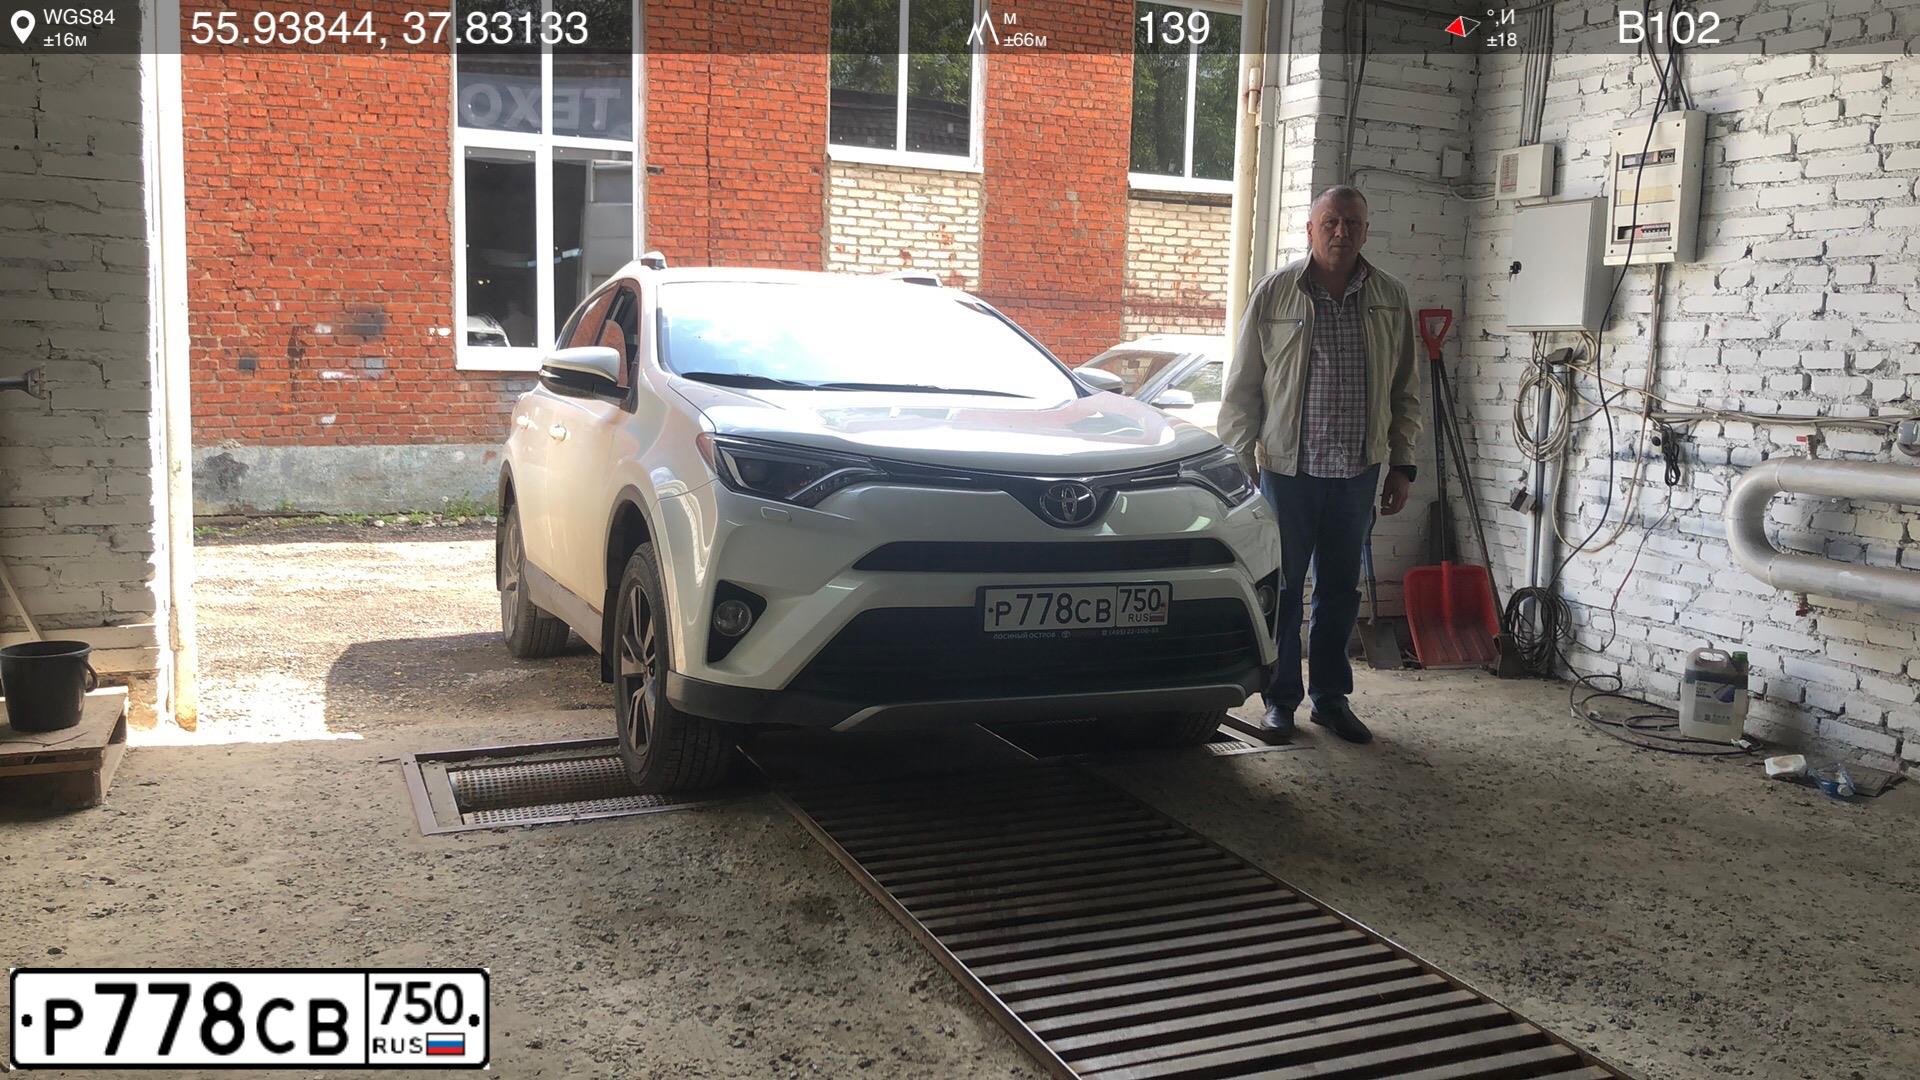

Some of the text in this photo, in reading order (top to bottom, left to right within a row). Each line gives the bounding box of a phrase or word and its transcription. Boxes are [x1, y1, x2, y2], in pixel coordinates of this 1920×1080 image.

[995, 593, 1111, 626] Р778СВ
[1119, 588, 1161, 613] 750
[1128, 613, 1149, 622] RUS
